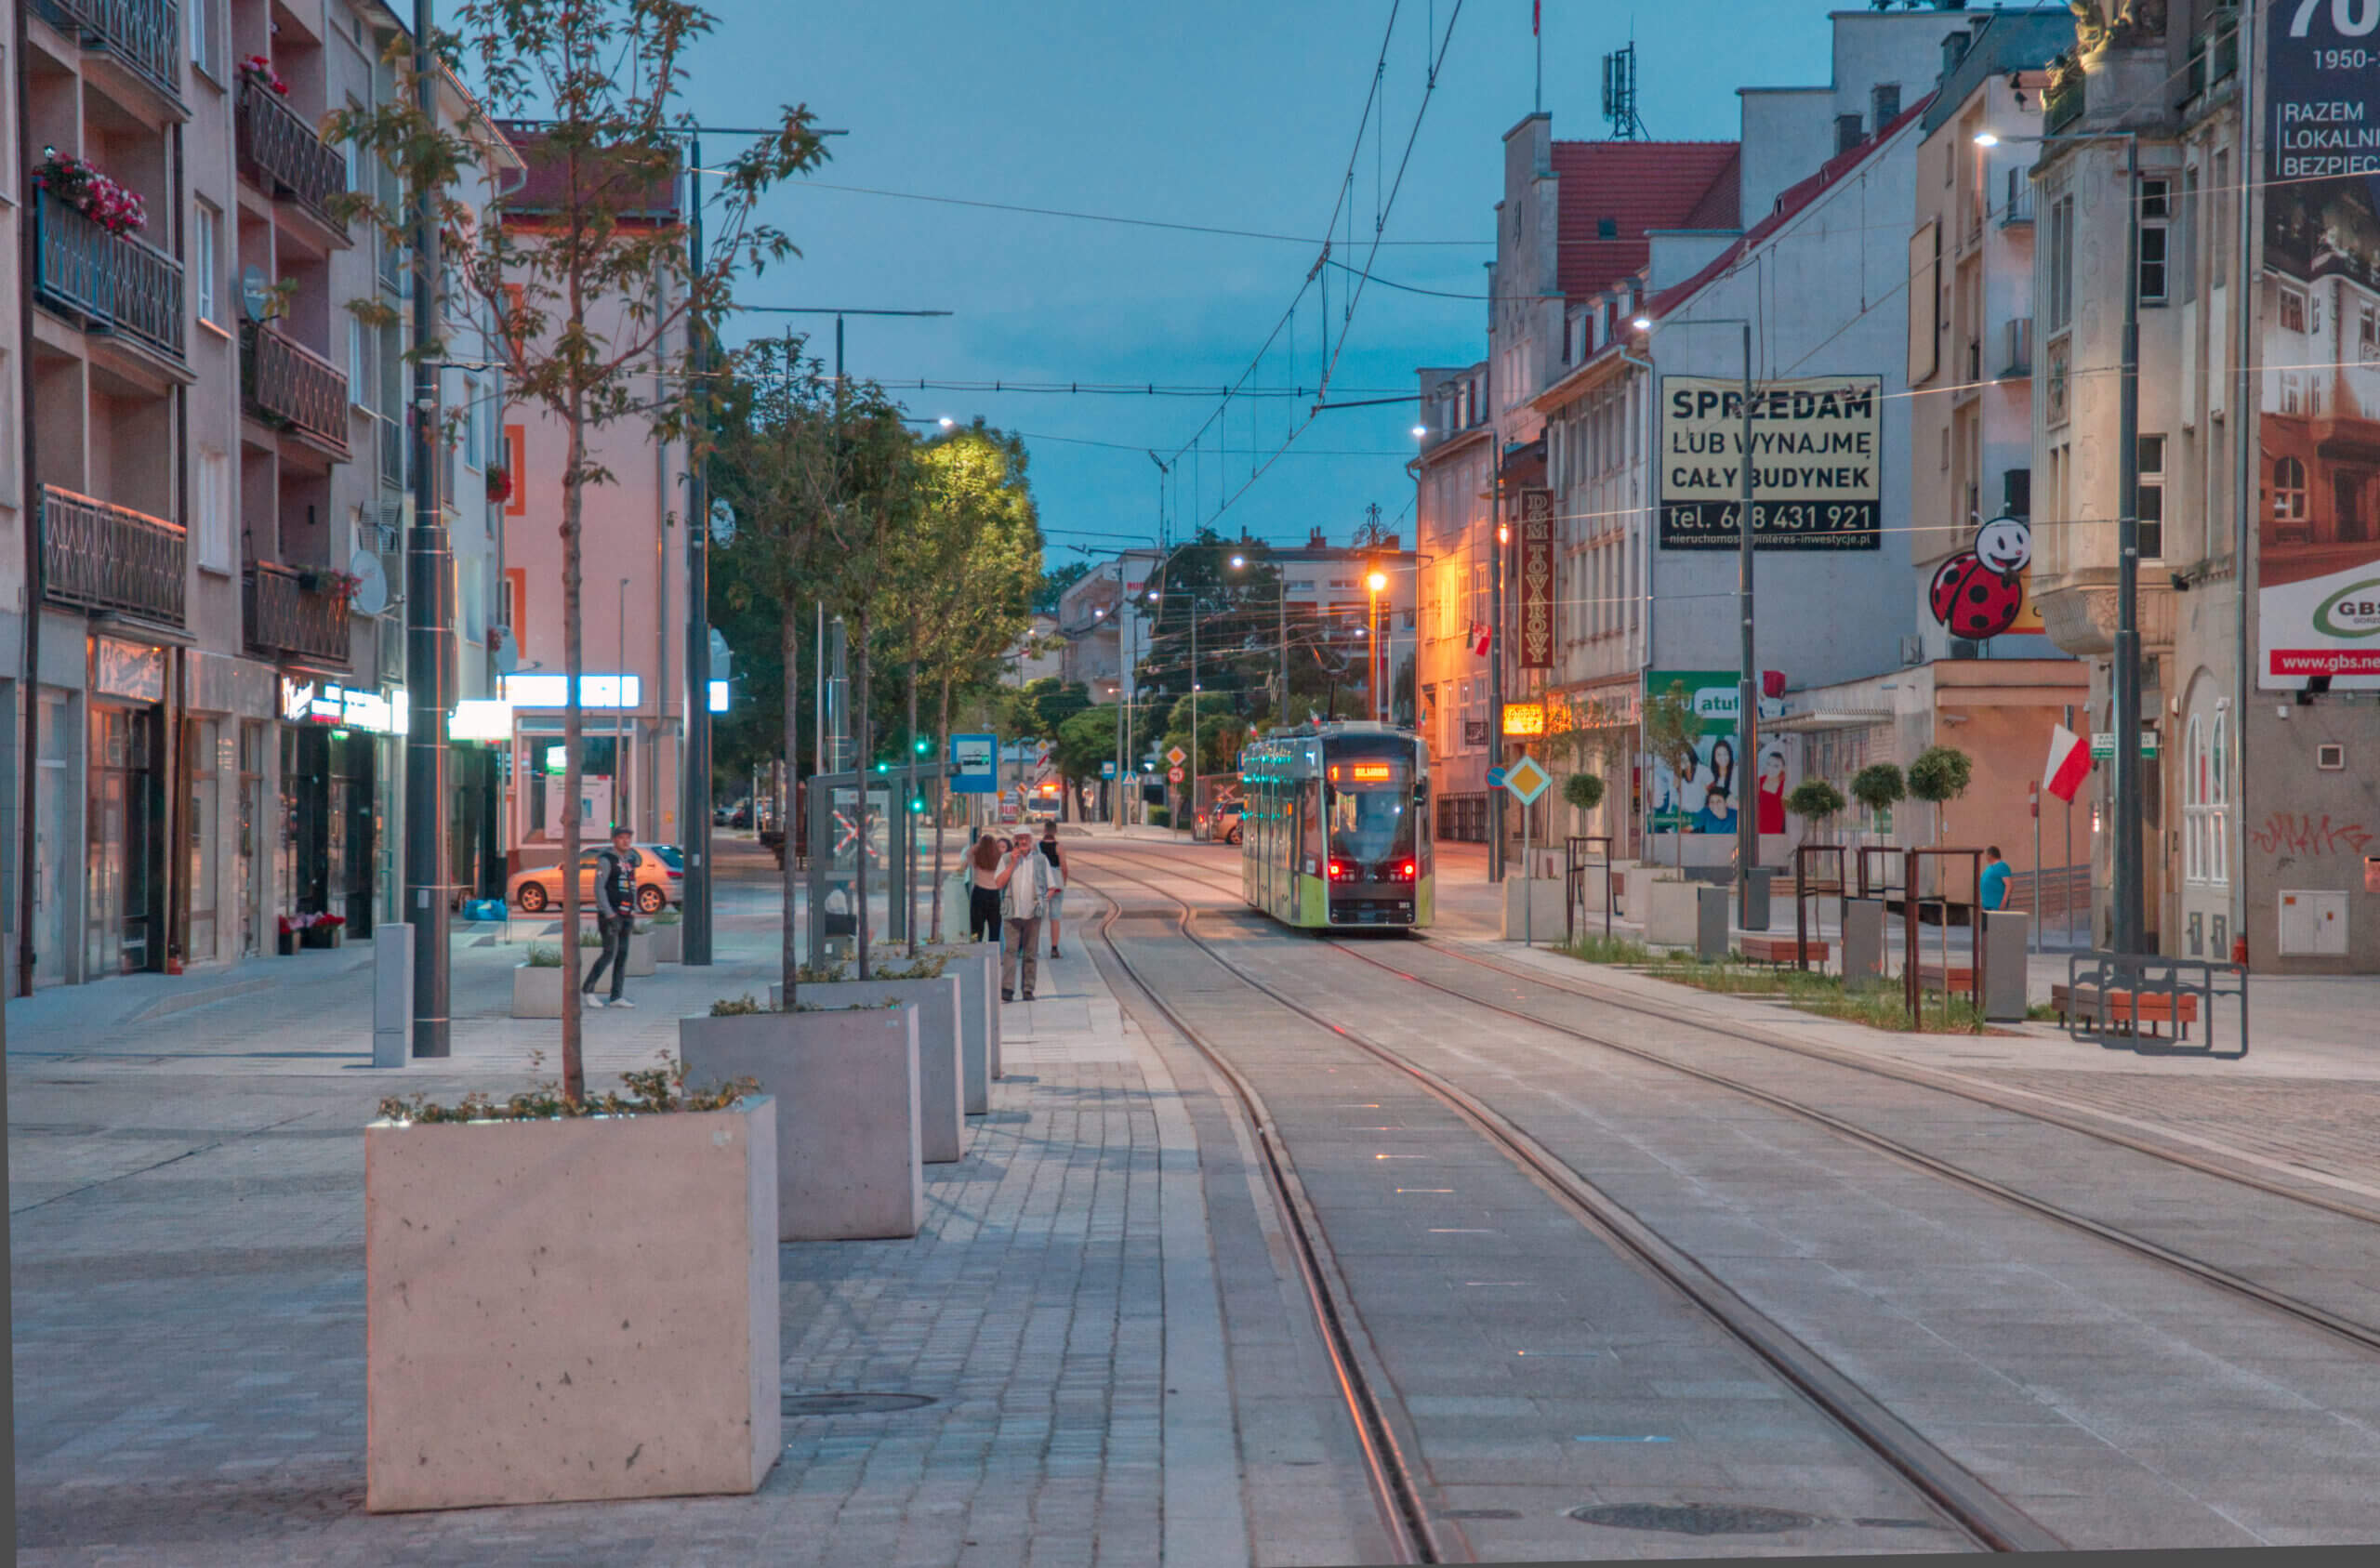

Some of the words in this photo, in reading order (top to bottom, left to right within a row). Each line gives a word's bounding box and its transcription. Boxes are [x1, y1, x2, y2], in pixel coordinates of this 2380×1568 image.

[2313, 49, 2380, 69] 1950-
[2284, 101, 2364, 122] RAZEM
[1673, 390, 1871, 419] SPRZEDAM
[1673, 432, 1726, 454] LUB
[1734, 432, 1871, 459] WYNAJMĘ
[1672, 468, 1738, 488] CAŁY
[1751, 468, 1870, 488] BUDYNEK
[1526, 494, 1549, 539] DOM
[1671, 506, 1712, 528] tel.
[1773, 506, 1816, 528] 431
[1827, 506, 1871, 528] 921
[1526, 545, 1550, 663] TOWAROWY
[2338, 601, 2380, 616] GB
[1331, 766, 1339, 780] 1
